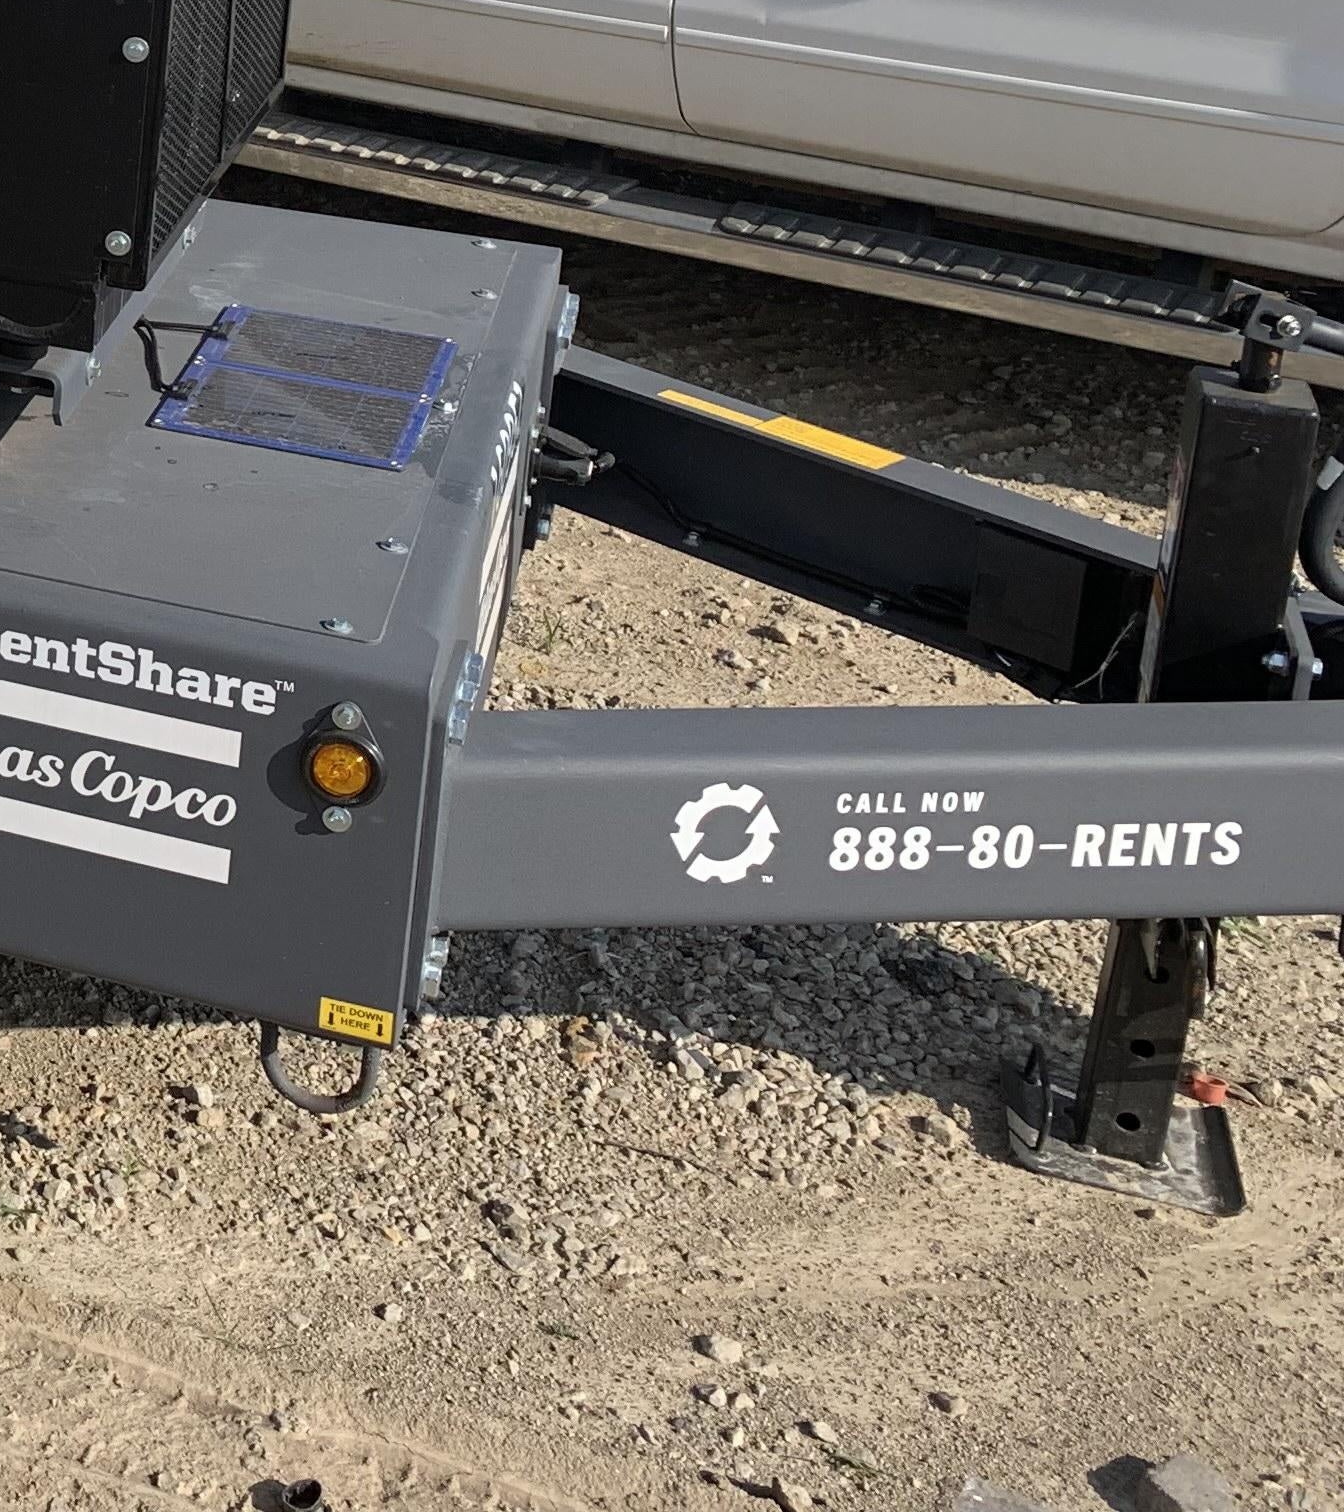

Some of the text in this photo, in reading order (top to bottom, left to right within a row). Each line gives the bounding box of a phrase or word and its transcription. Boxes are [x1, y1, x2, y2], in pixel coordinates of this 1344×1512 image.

[70, 749, 238, 828] Copco
[836, 790, 986, 815] CALL NOW
[829, 820, 1243, 872] 888-80-RENTS
[329, 1003, 384, 1023] TIE DOWN
[340, 1016, 372, 1031] HERE
